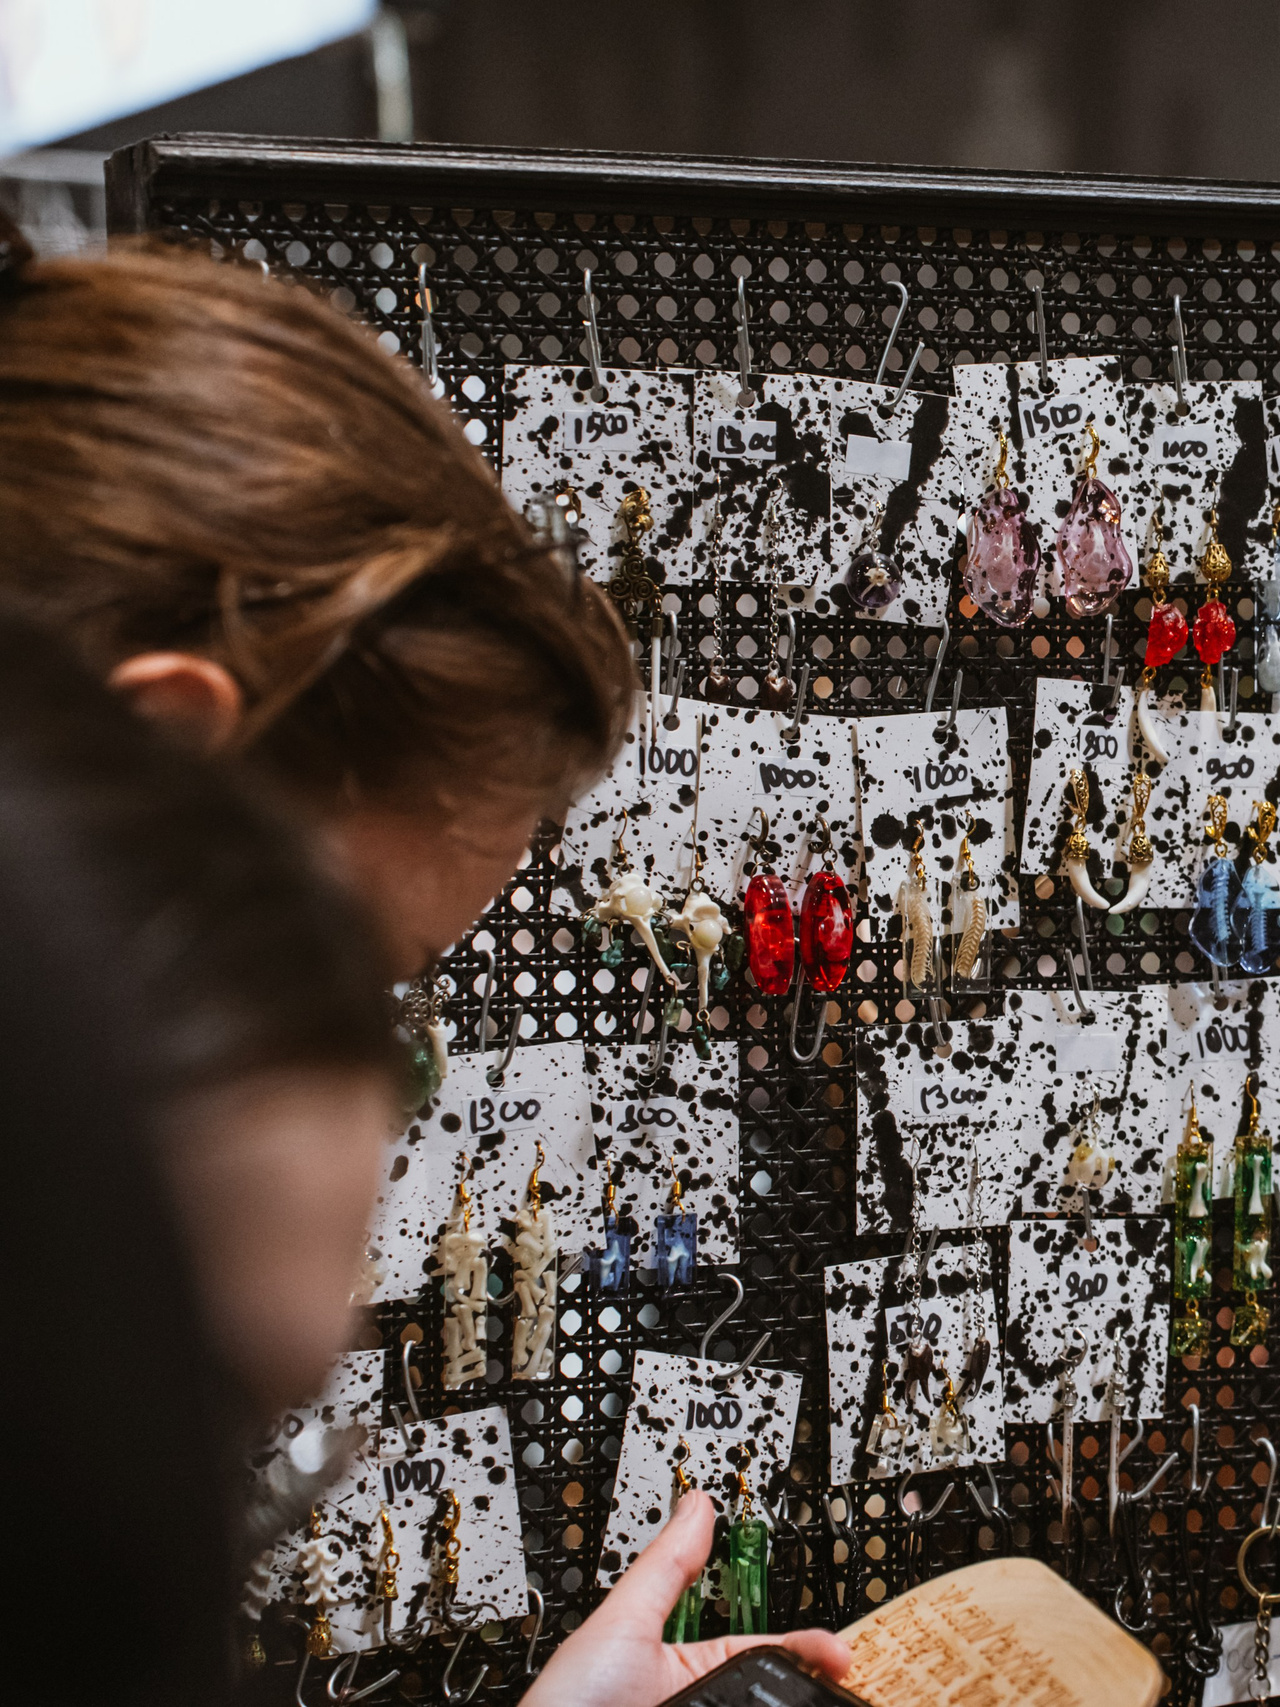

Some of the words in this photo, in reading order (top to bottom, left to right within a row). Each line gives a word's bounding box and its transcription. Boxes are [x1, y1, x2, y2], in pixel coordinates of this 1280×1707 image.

[574, 412, 628, 444] 1500
[1023, 402, 1083, 438] 1500
[1162, 440, 1208, 458] 1000
[639, 746, 698, 778] 1000
[759, 762, 816, 793] 1000
[913, 763, 968, 792] 1000
[1206, 755, 1254, 783] 900
[1197, 1024, 1250, 1057] 1000
[921, 1086, 980, 1114] 1300
[469, 1099, 541, 1134] 1300
[686, 1400, 742, 1430] 1000
[384, 1458, 445, 1503] 1000
